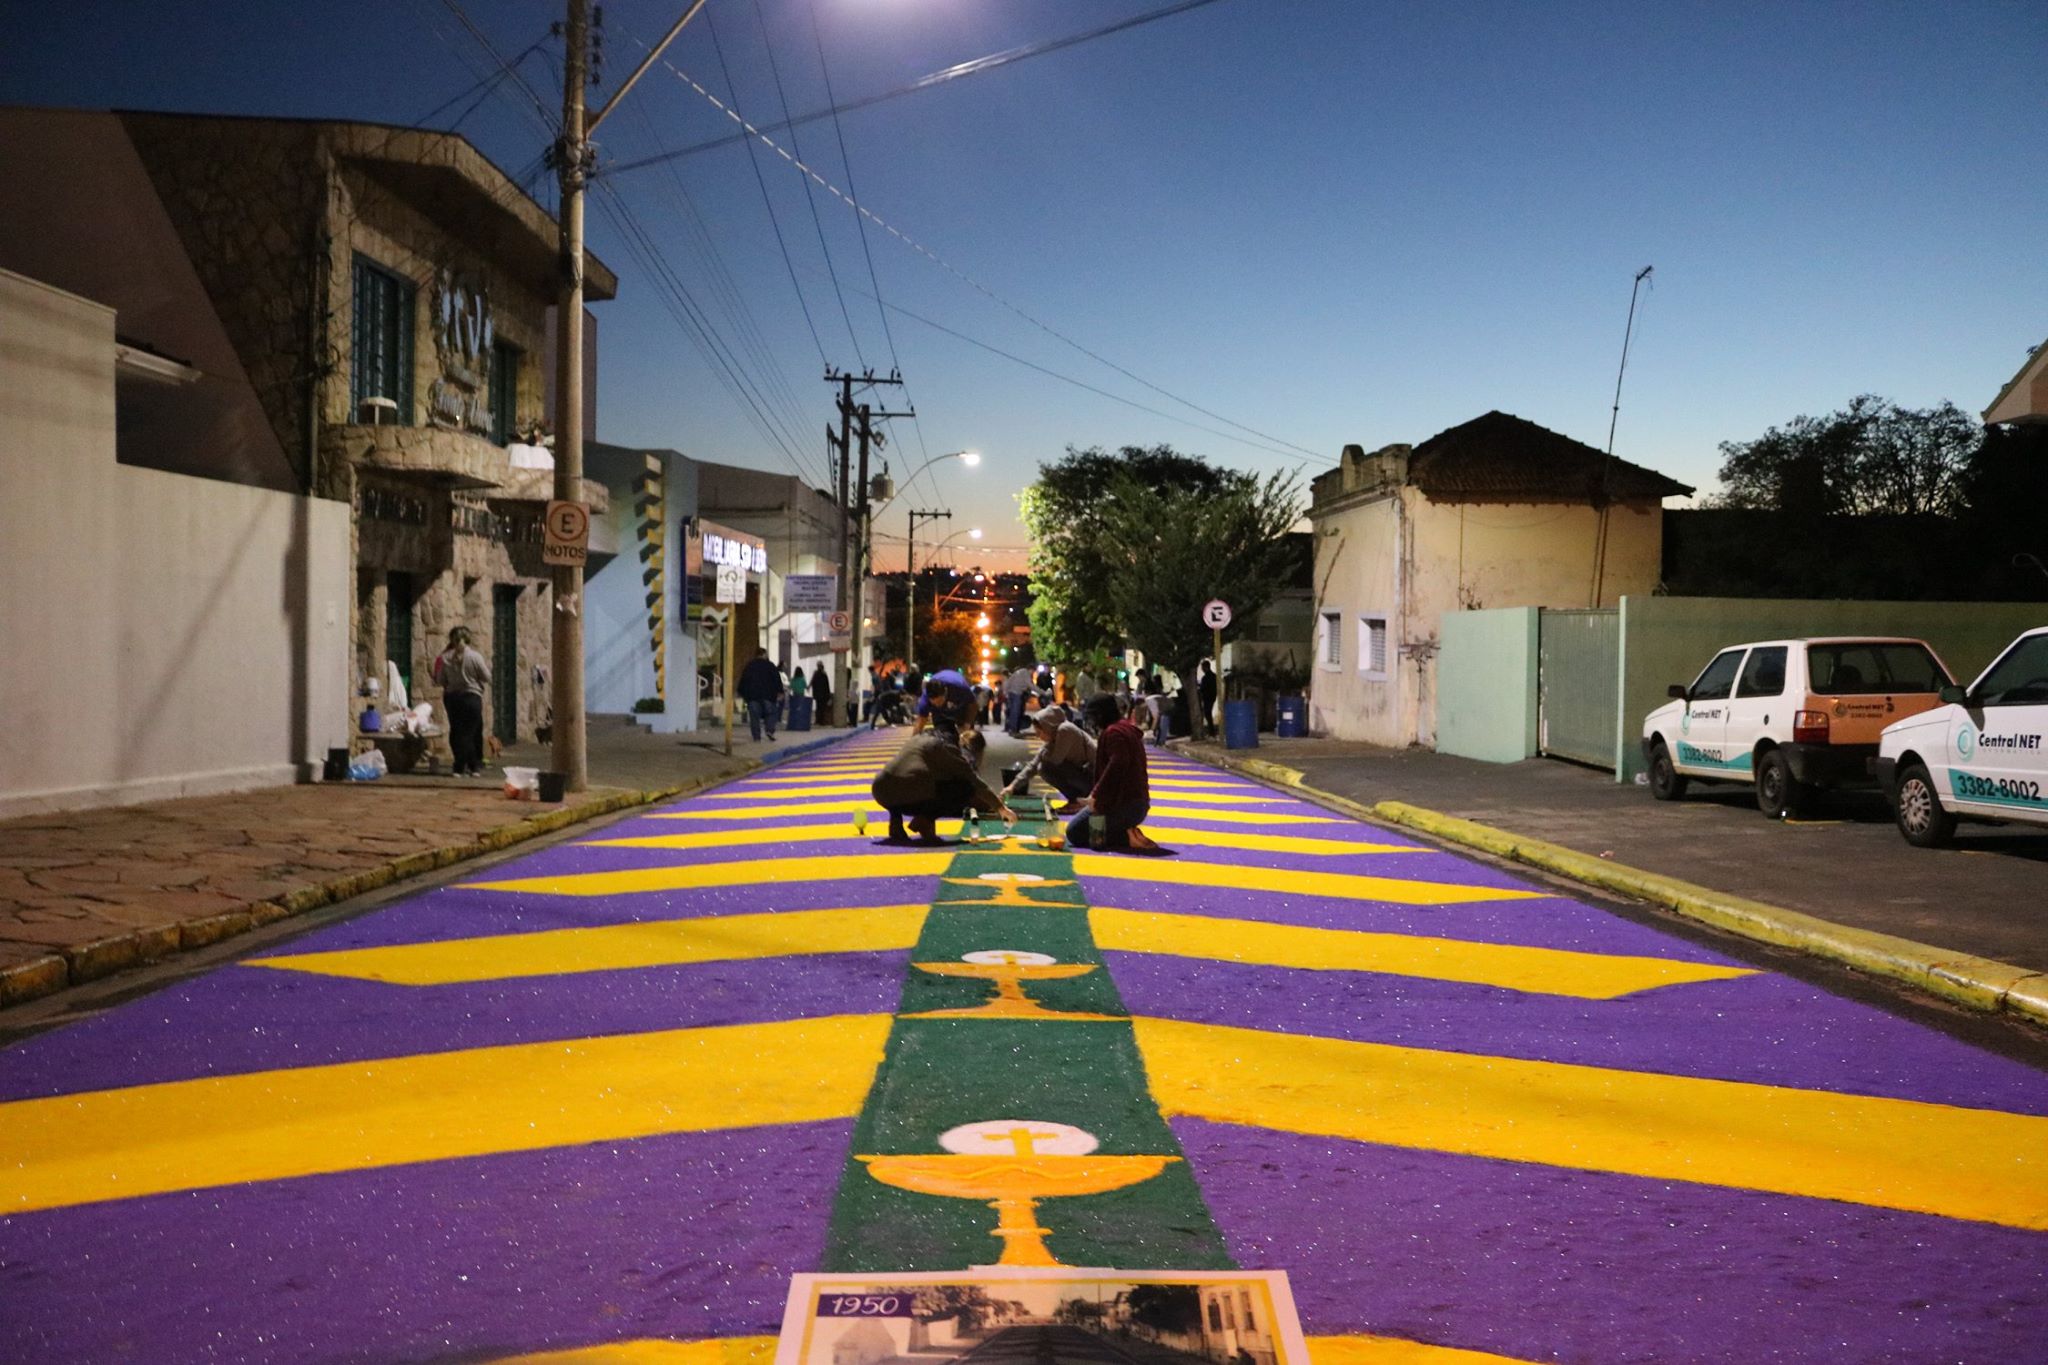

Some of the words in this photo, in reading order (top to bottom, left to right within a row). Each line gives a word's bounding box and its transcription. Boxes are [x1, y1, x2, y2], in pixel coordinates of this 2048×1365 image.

[561, 513, 575, 534] E
[545, 545, 585, 559] MOTOS
[1691, 709, 1710, 719] Central
[1710, 708, 1721, 719] NET
[1978, 733, 2018, 748] Central
[2019, 734, 2042, 749] NET
[1683, 747, 1724, 763] 3382-8002
[1958, 775, 2042, 801] 3382-8002
[832, 1296, 900, 1315] 1950
